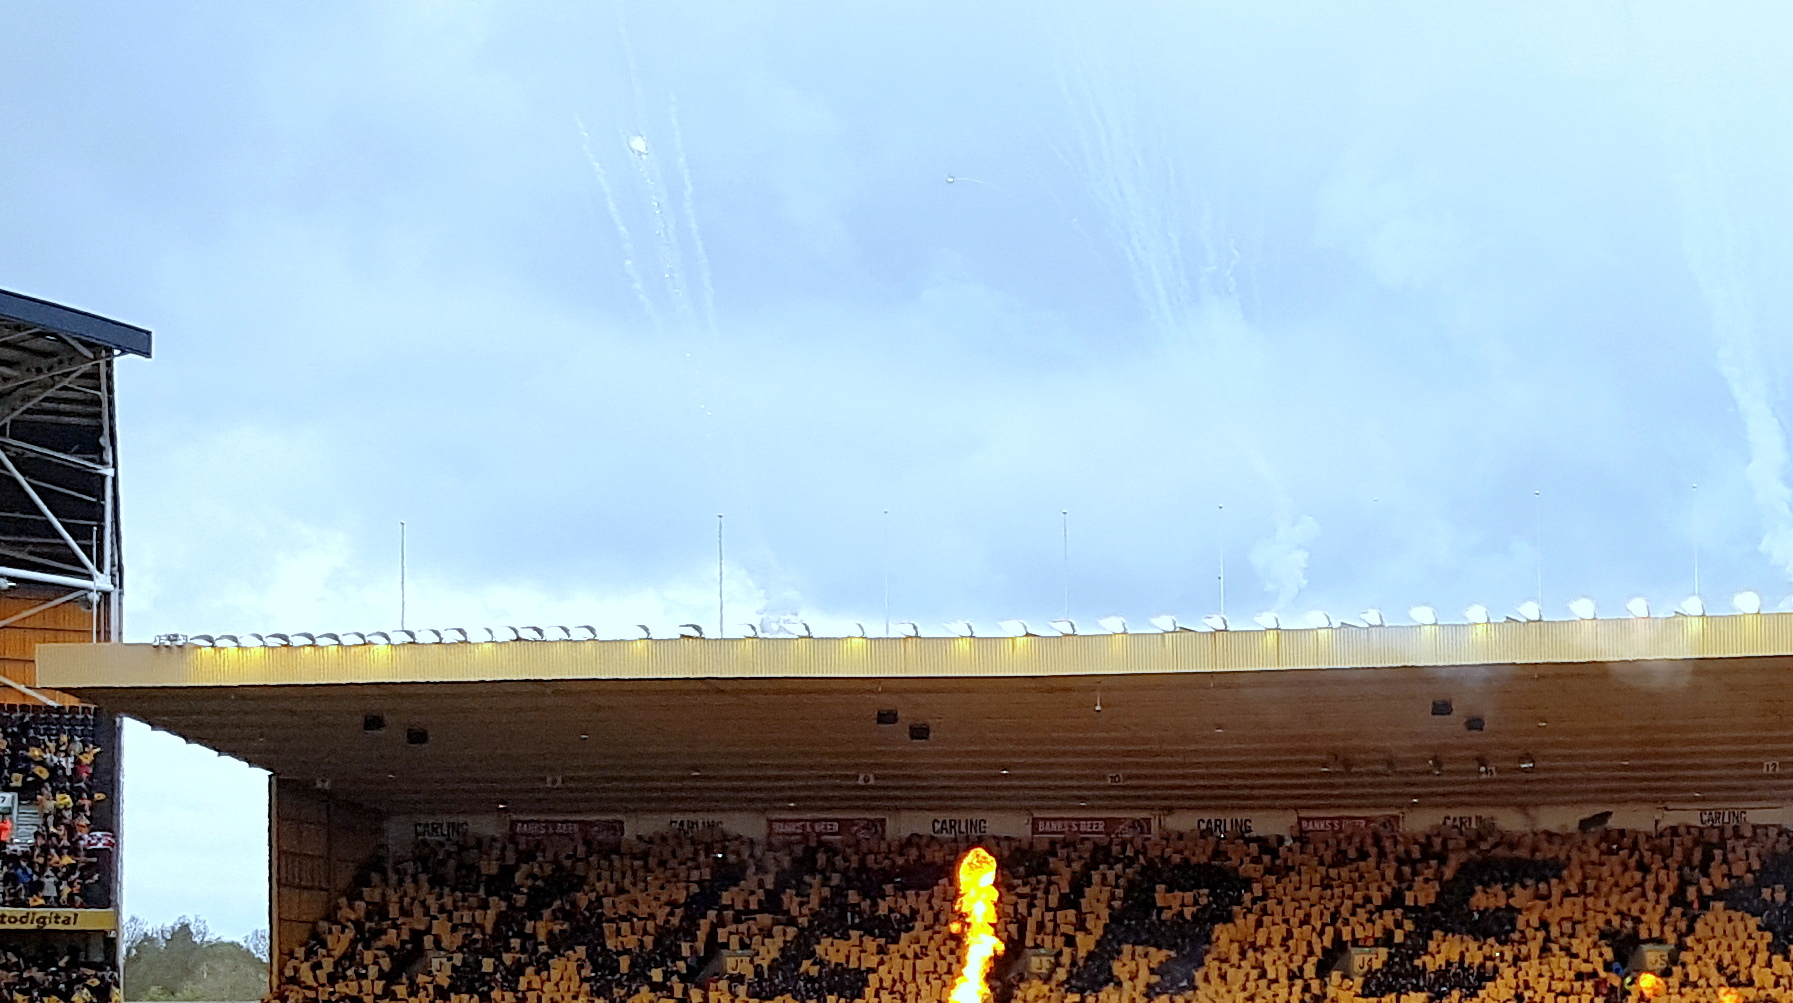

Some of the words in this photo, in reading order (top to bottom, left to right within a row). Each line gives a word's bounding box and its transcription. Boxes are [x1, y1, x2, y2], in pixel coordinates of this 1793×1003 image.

[1699, 811, 1747, 825] CARLING
[932, 818, 987, 835] CARLING
[1197, 819, 1252, 834] CARLING
